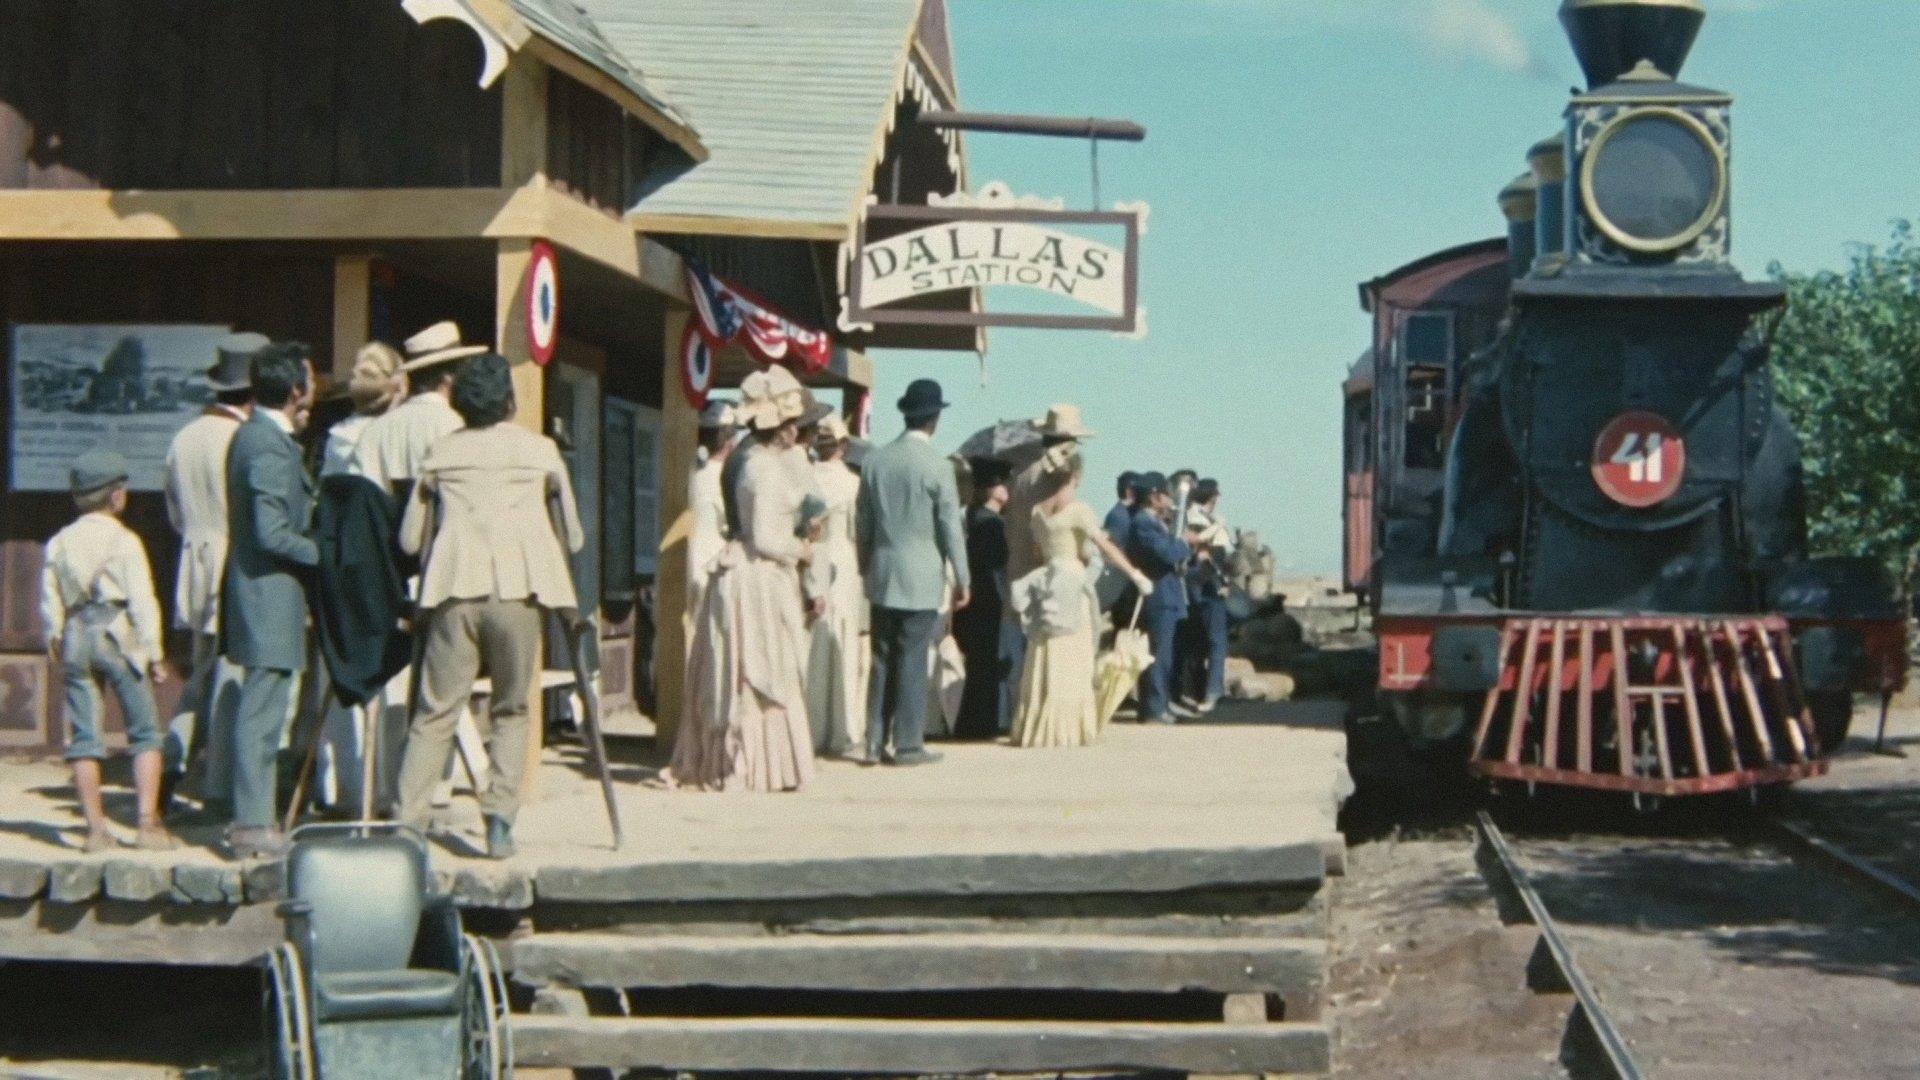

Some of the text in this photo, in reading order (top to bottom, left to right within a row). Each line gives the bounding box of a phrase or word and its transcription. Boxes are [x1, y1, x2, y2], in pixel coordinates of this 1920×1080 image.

[866, 228, 1108, 280] DALLAS
[912, 264, 1077, 294] STATION
[1610, 432, 1662, 482] 41
